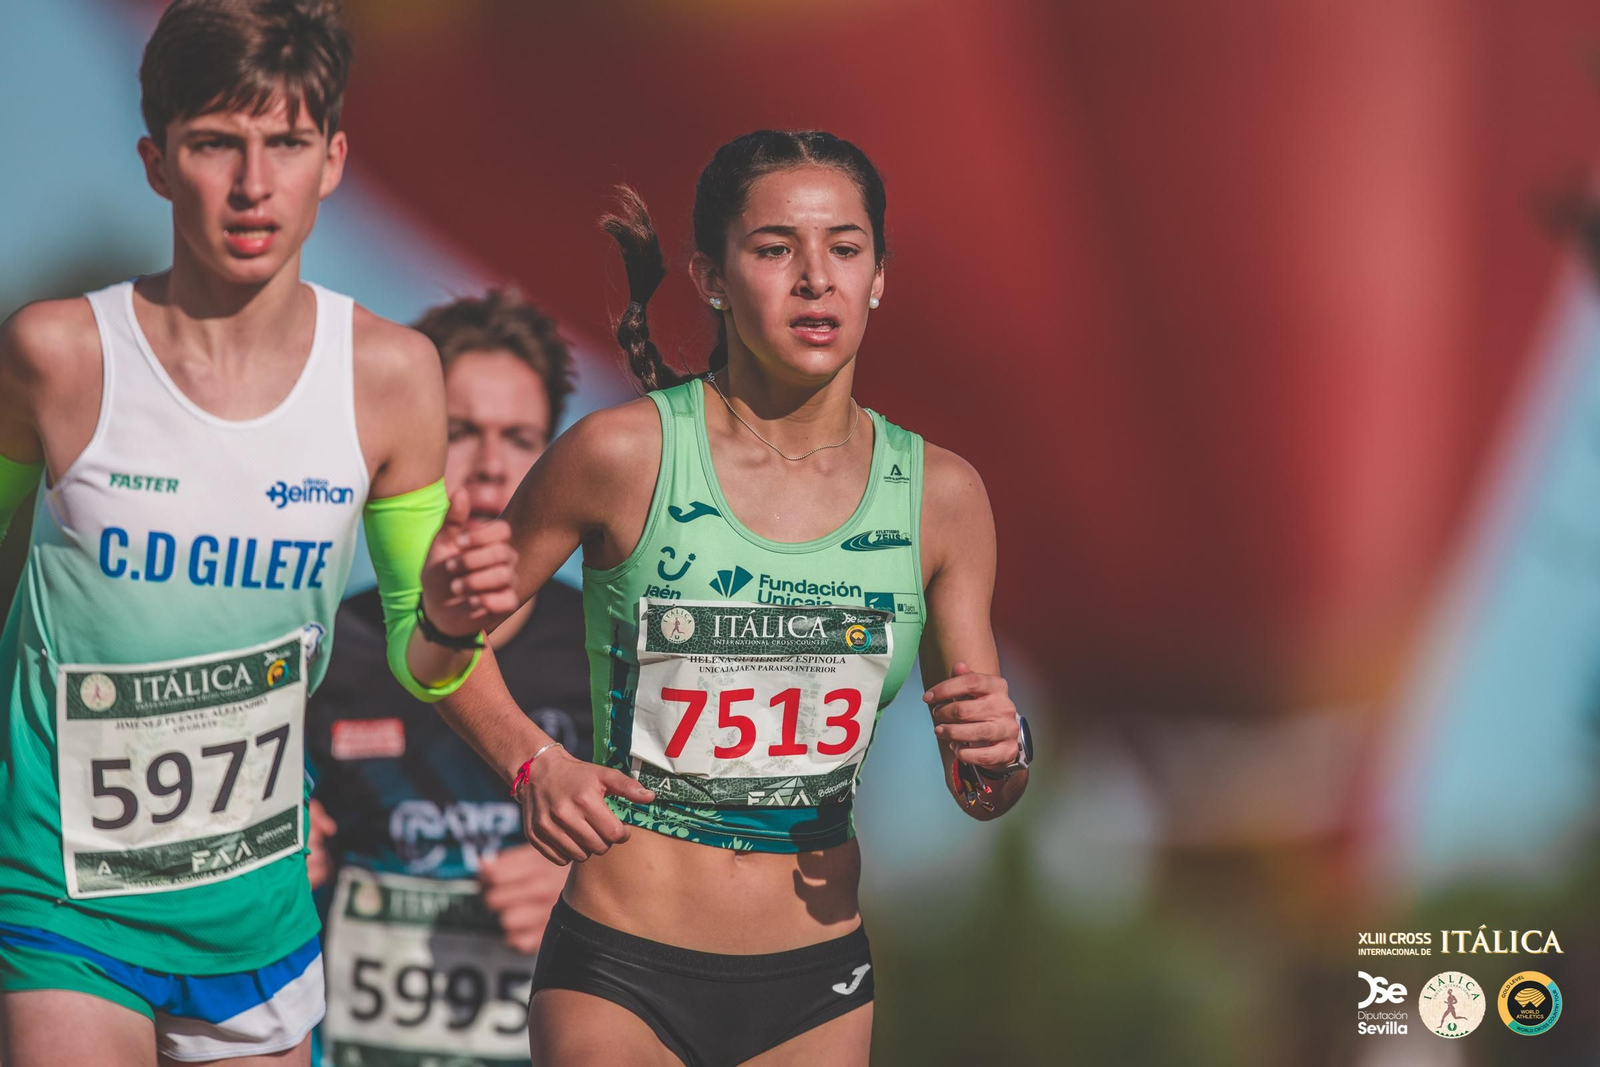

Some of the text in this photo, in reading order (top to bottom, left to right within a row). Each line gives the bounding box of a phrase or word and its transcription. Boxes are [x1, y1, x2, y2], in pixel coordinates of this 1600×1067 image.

[109, 473, 179, 493] FASTER
[266, 480, 354, 509] Beiman
[876, 534, 901, 542] ZEUS
[100, 526, 333, 590] C.D GILETE
[759, 573, 862, 598] Fundación
[713, 609, 828, 638] ITÁLICA
[690, 655, 846, 664] HELENA GUTIERREZ ESPINOLA
[735, 664, 756, 672] JAEN
[134, 662, 253, 703] ITÁLICA
[661, 687, 862, 759] 7513
[91, 723, 290, 830] 5977
[351, 957, 532, 1034] 5995
